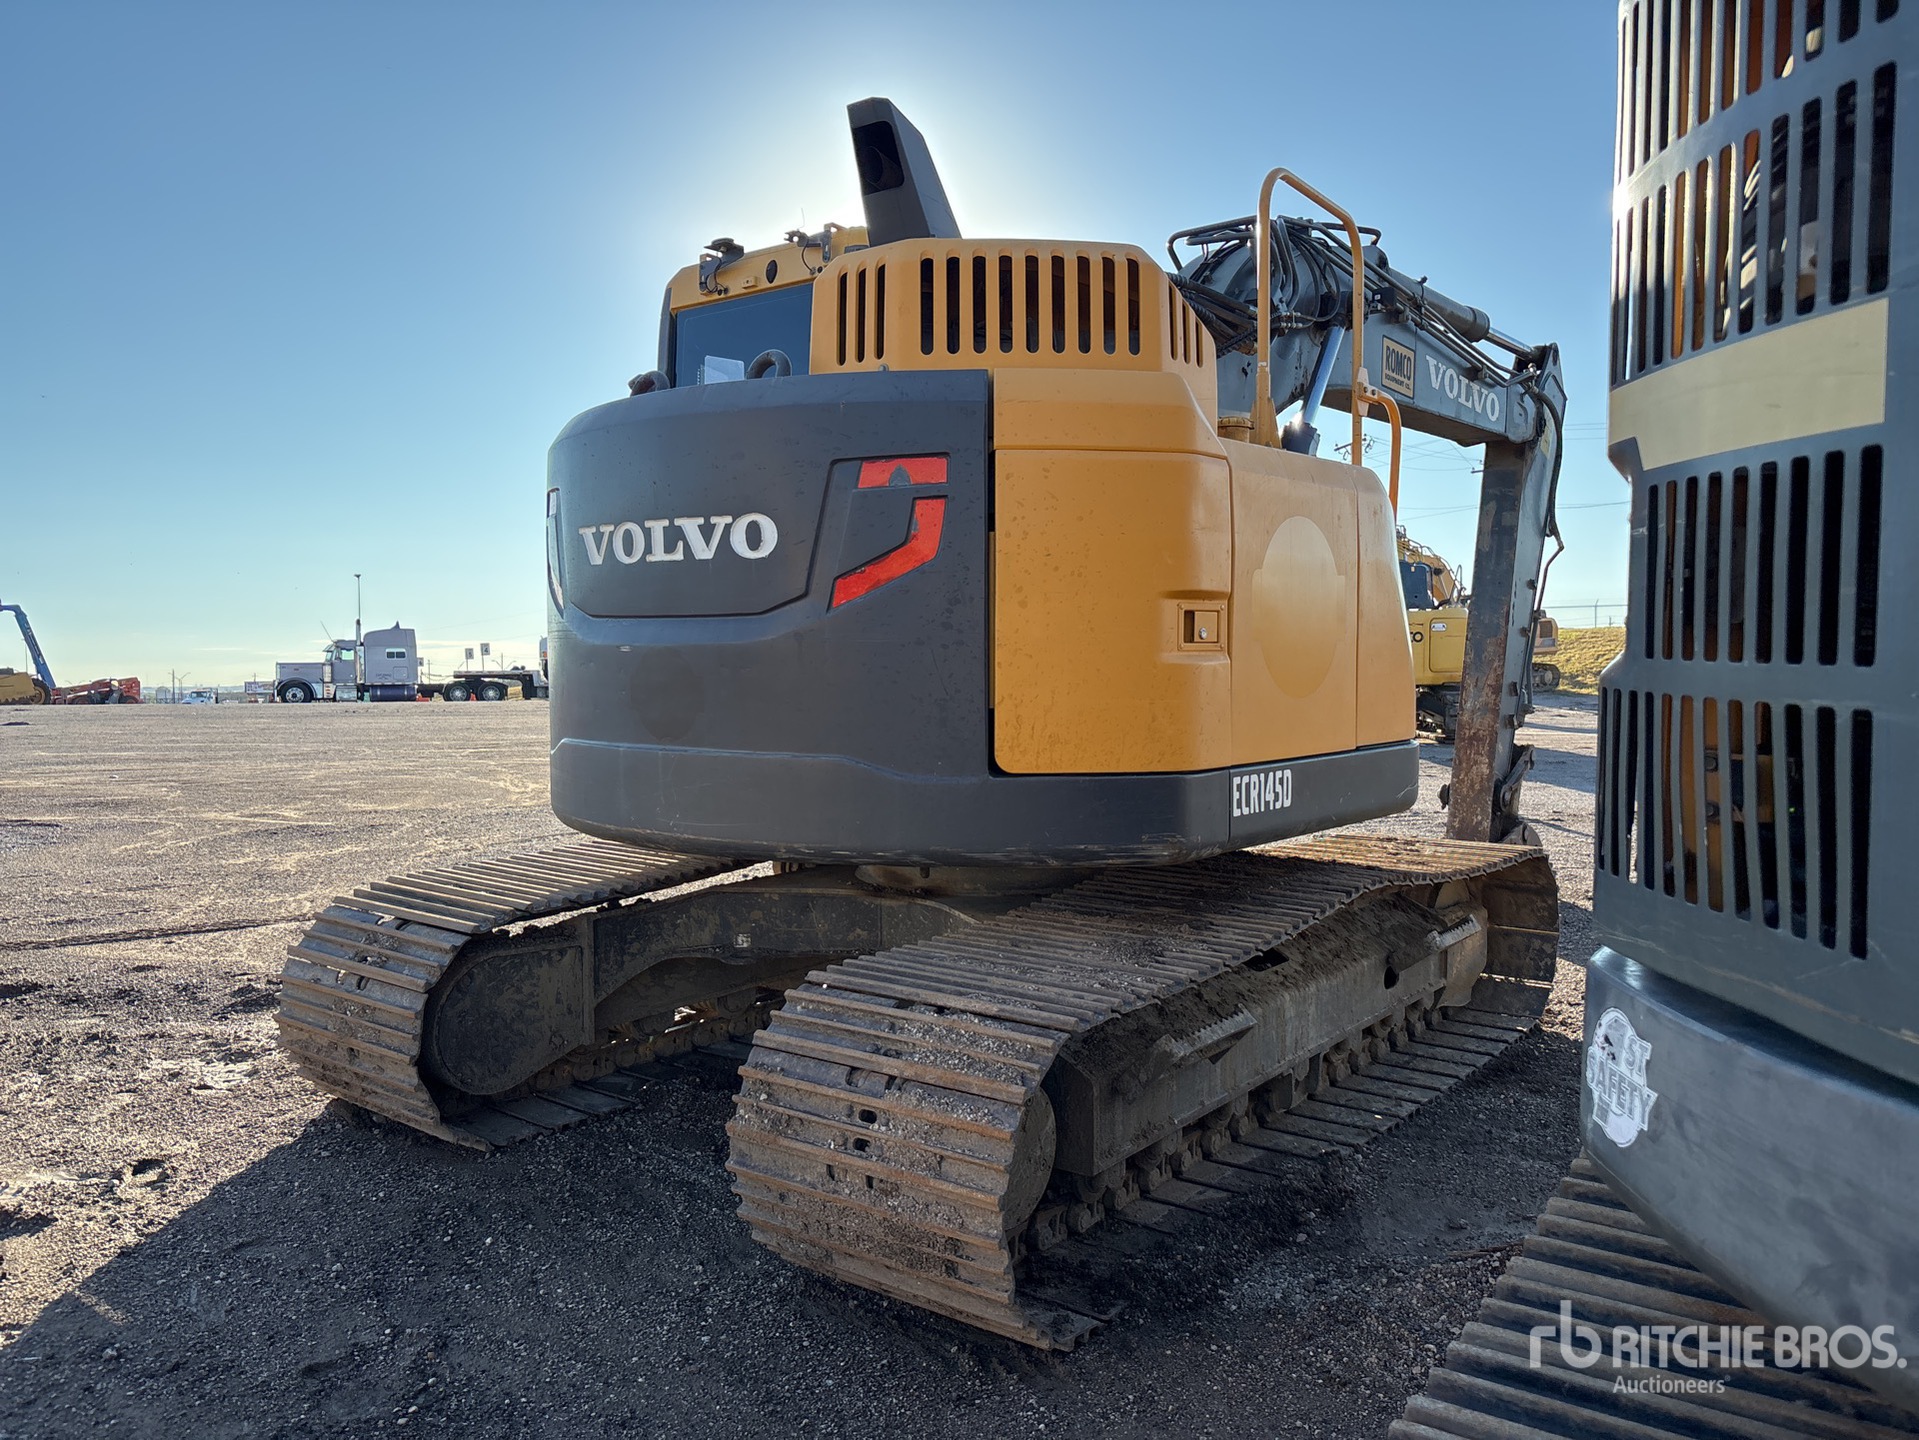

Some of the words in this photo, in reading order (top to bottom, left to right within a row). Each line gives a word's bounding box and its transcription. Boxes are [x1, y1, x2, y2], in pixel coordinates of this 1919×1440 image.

[1385, 345, 1412, 381] ROMCO
[1425, 354, 1500, 422] VOLVO
[578, 512, 779, 566] VOLVO
[1232, 768, 1292, 818] ECR145D
[1587, 1049, 1655, 1130] SAFETY
